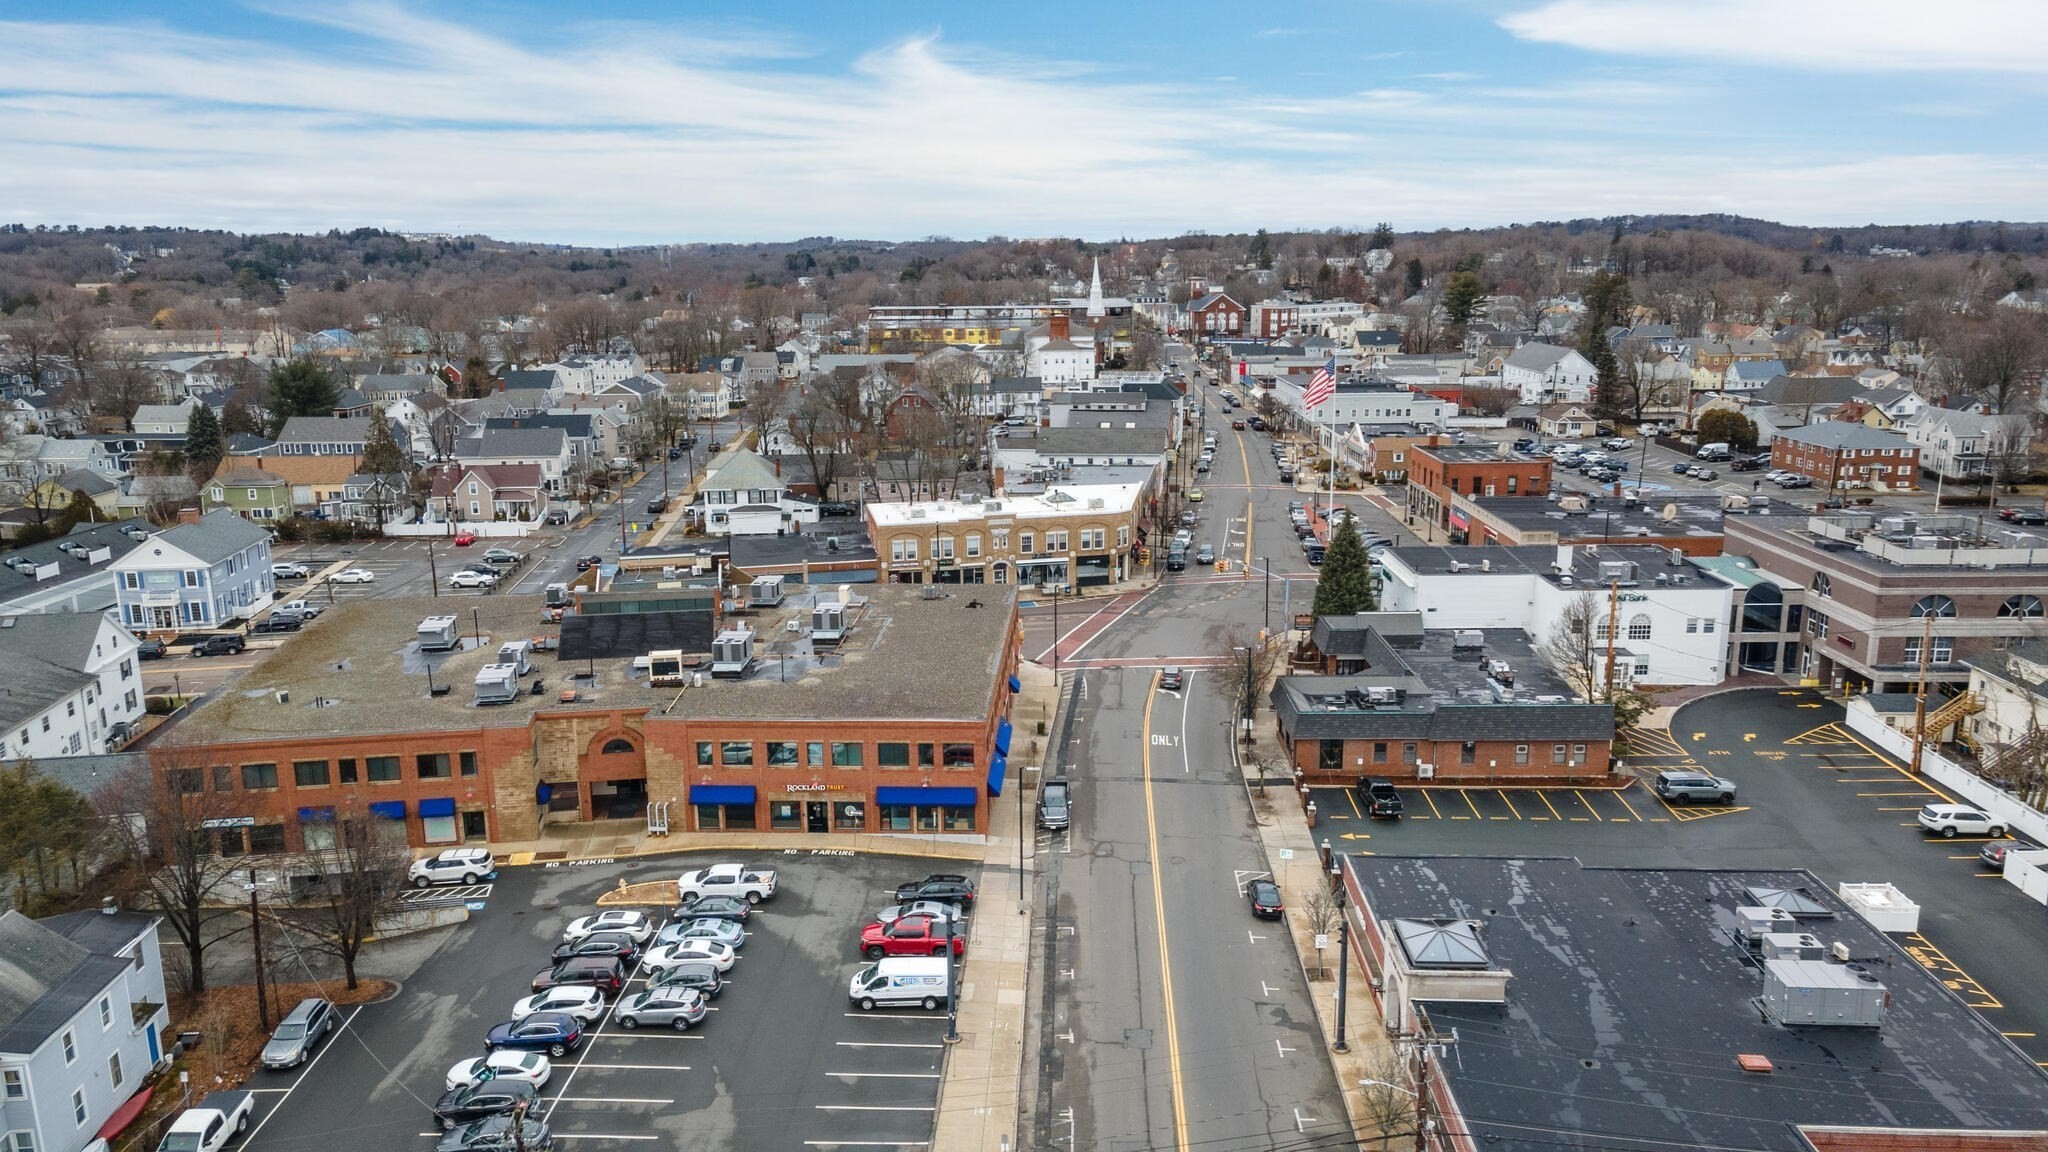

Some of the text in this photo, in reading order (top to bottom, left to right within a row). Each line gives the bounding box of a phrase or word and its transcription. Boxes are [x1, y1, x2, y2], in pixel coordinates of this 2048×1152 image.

[1151, 734, 1179, 747] ONLY
[810, 849, 856, 857] PARKING
[568, 858, 615, 867] PARKING
